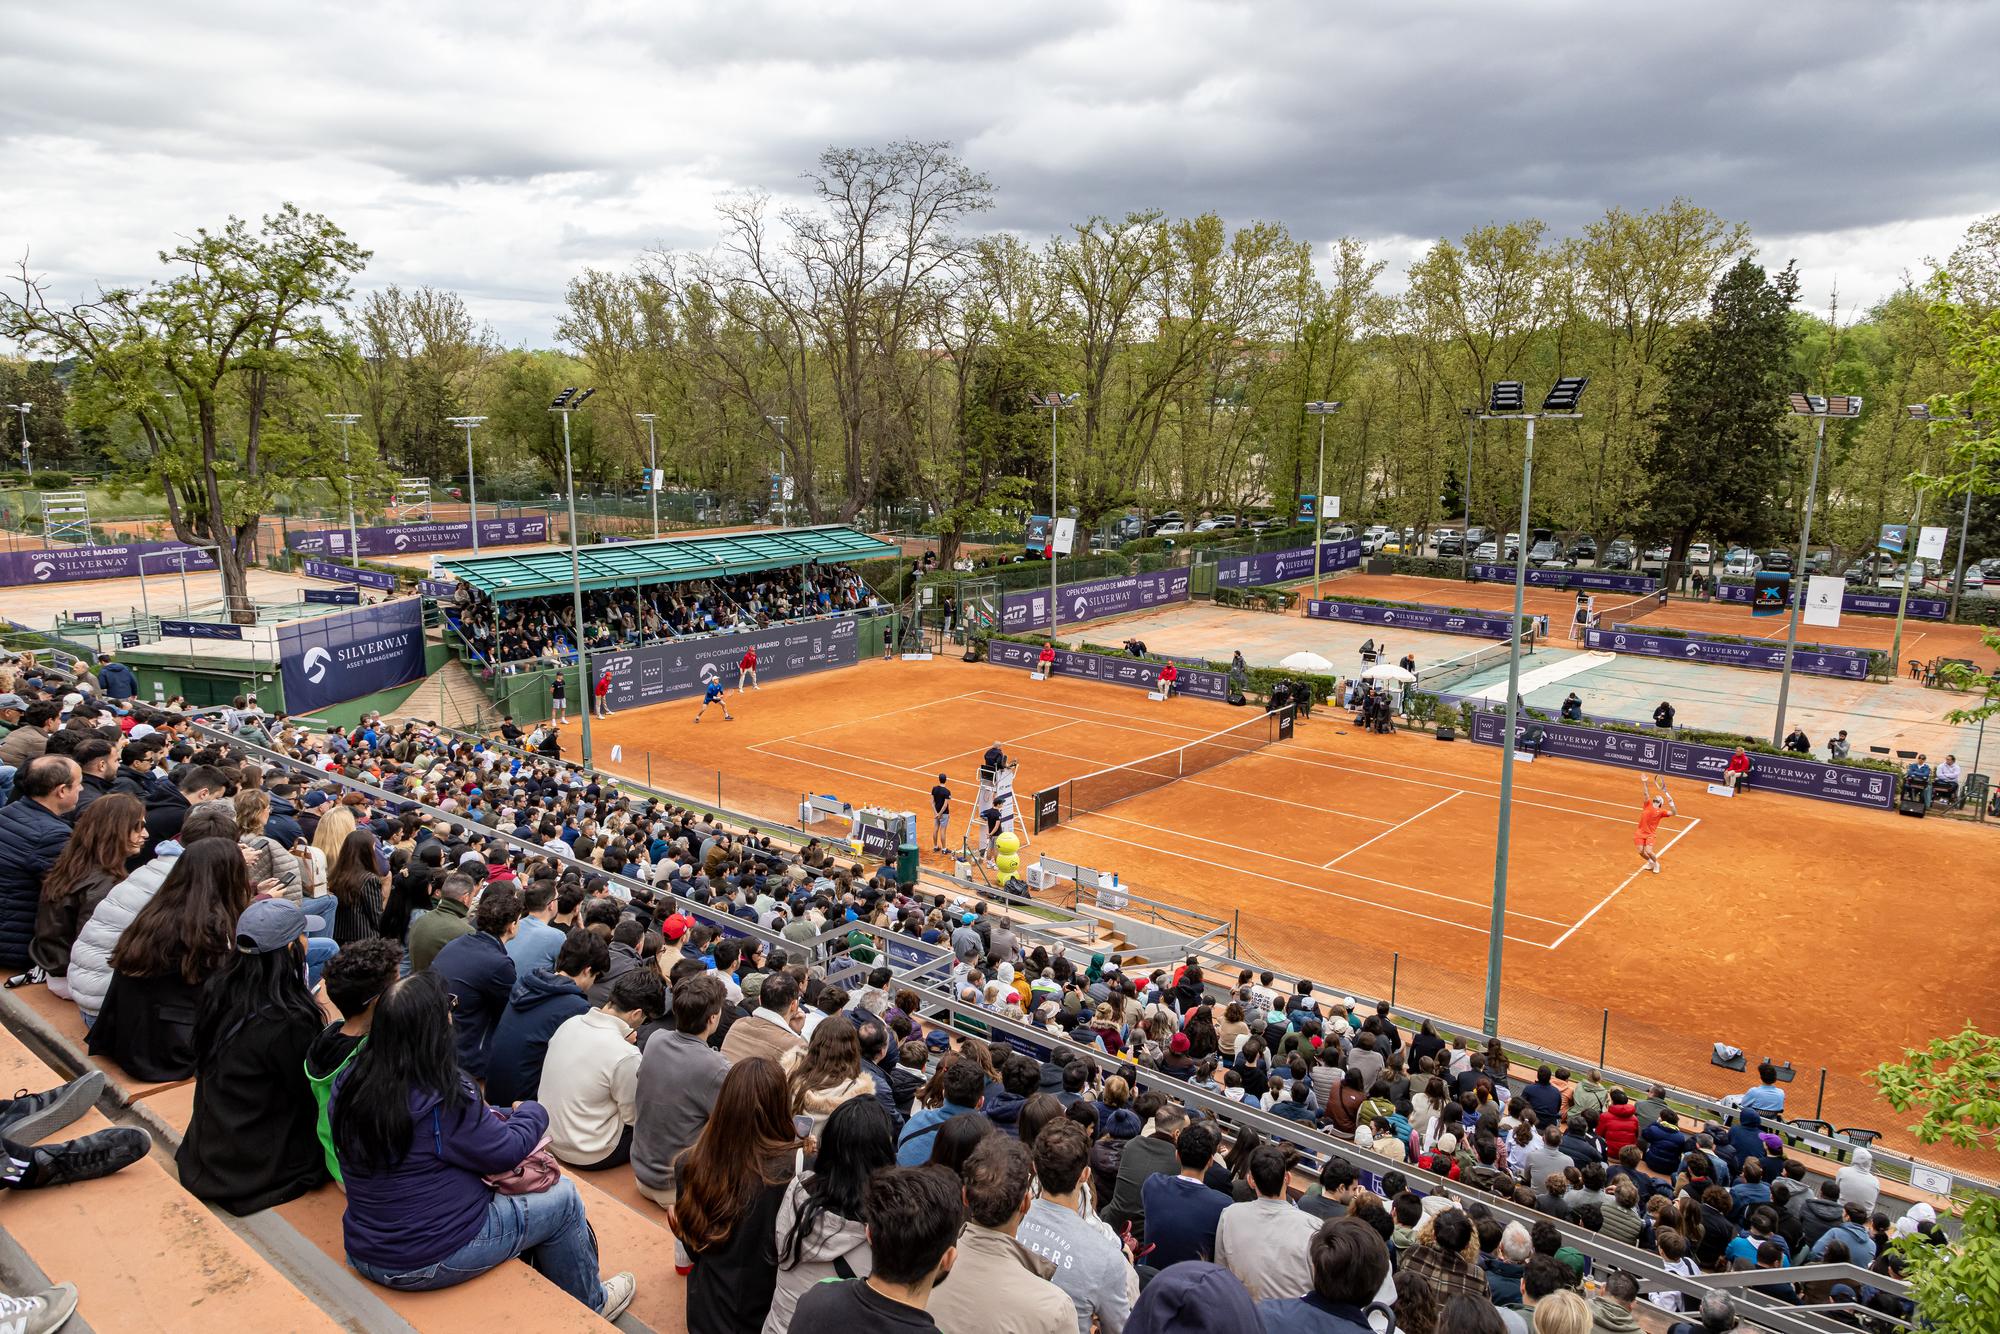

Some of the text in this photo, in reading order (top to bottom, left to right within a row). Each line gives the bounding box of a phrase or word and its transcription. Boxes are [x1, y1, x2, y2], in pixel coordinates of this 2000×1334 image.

[402, 526, 437, 534] COMUNIDAD
[522, 523, 544, 532] ATP
[296, 538, 324, 549] ATP
[412, 532, 461, 542] SILVERWAY
[93, 548, 128, 556] MADRID
[59, 558, 129, 571] SILVERWAY
[1286, 558, 1314, 569] SILVERWAY
[1067, 588, 1080, 596] OPEN
[1080, 582, 1110, 594] COMUNIDAD
[1117, 579, 1136, 588] MADRID
[1170, 577, 1187, 590] ATP
[1090, 591, 1131, 607] SILVERWAY
[1003, 605, 1027, 620] ATP
[1396, 614, 1432, 622] SILVERWAY
[832, 621, 855, 634] ATP
[338, 634, 409, 661] SILVERWAY
[696, 651, 711, 660] OPEN
[712, 646, 748, 657] COMUNIDAD
[757, 641, 780, 649] MADRID
[1702, 646, 1750, 656] SILVERWAY
[347, 650, 404, 669] ASSET MANAGEMENT
[600, 656, 633, 672] ATP
[720, 654, 775, 672] SILVWAY
[1119, 667, 1137, 675] ATP
[1549, 733, 1600, 746] SILVERWAY
[1696, 756, 1728, 767] ATP
[1757, 765, 1816, 780] SILVERWAY
[1042, 800, 1056, 812] ATP
[866, 834, 884, 848] WTA
[1044, 1229, 1070, 1250] BRAND
